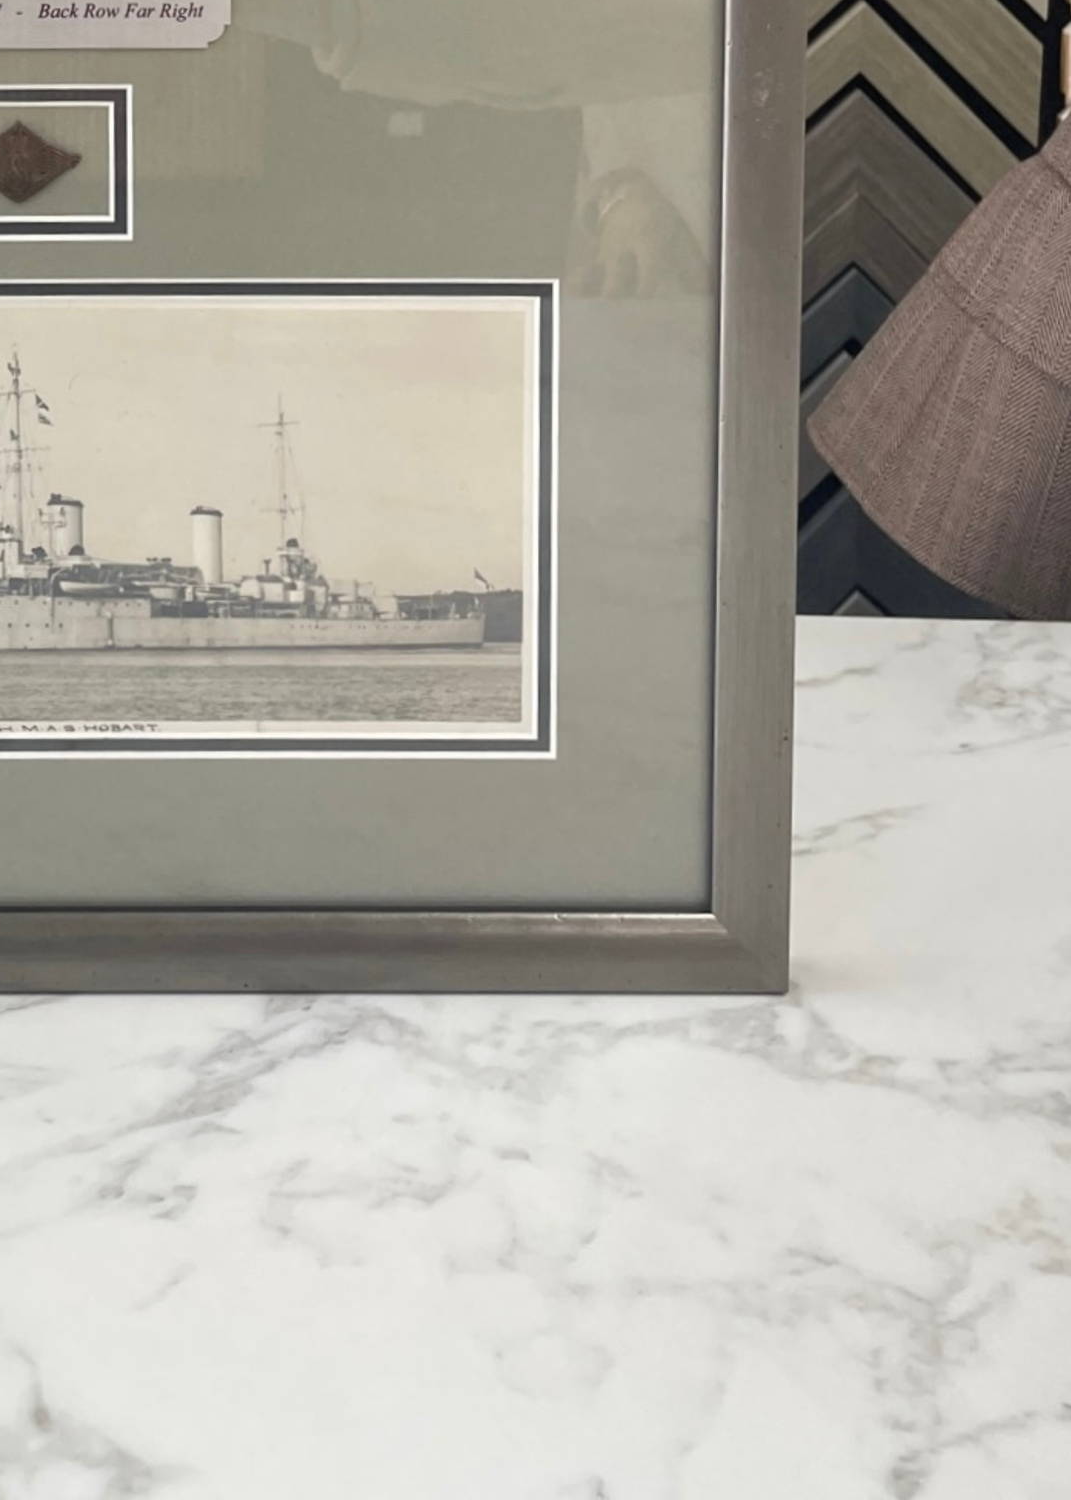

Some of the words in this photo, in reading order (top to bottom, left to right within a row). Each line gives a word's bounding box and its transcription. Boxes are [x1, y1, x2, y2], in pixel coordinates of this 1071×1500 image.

[38, 3, 78, 19] Back
[83, 3, 120, 19] Row
[124, 3, 155, 19] Far
[159, 2, 204, 22] Right
